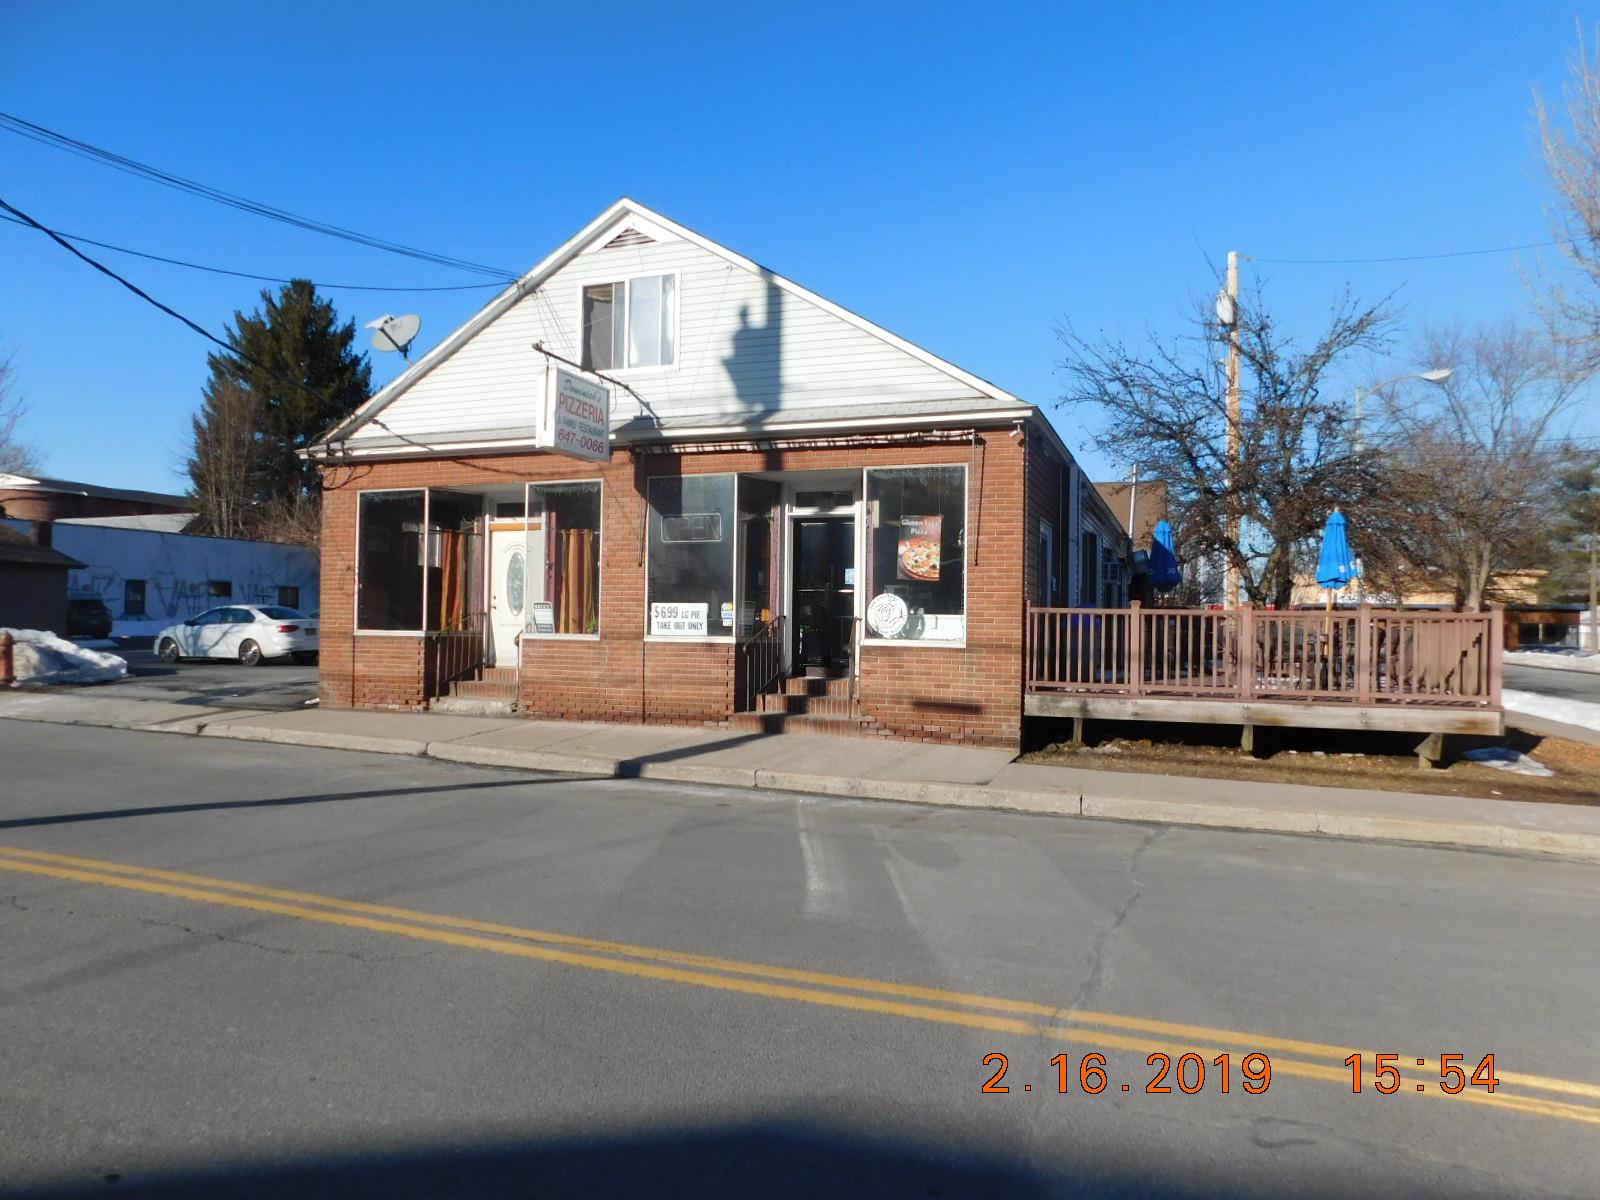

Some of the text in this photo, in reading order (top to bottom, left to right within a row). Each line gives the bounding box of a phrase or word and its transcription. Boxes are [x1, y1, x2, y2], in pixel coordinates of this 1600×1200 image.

[559, 392, 604, 425] PIZZERIA
[558, 428, 605, 454] 647-0066
[663, 515, 719, 540] OPEN
[910, 527, 928, 535] Pizza
[657, 621, 704, 630] TAKE OUT ONLY
